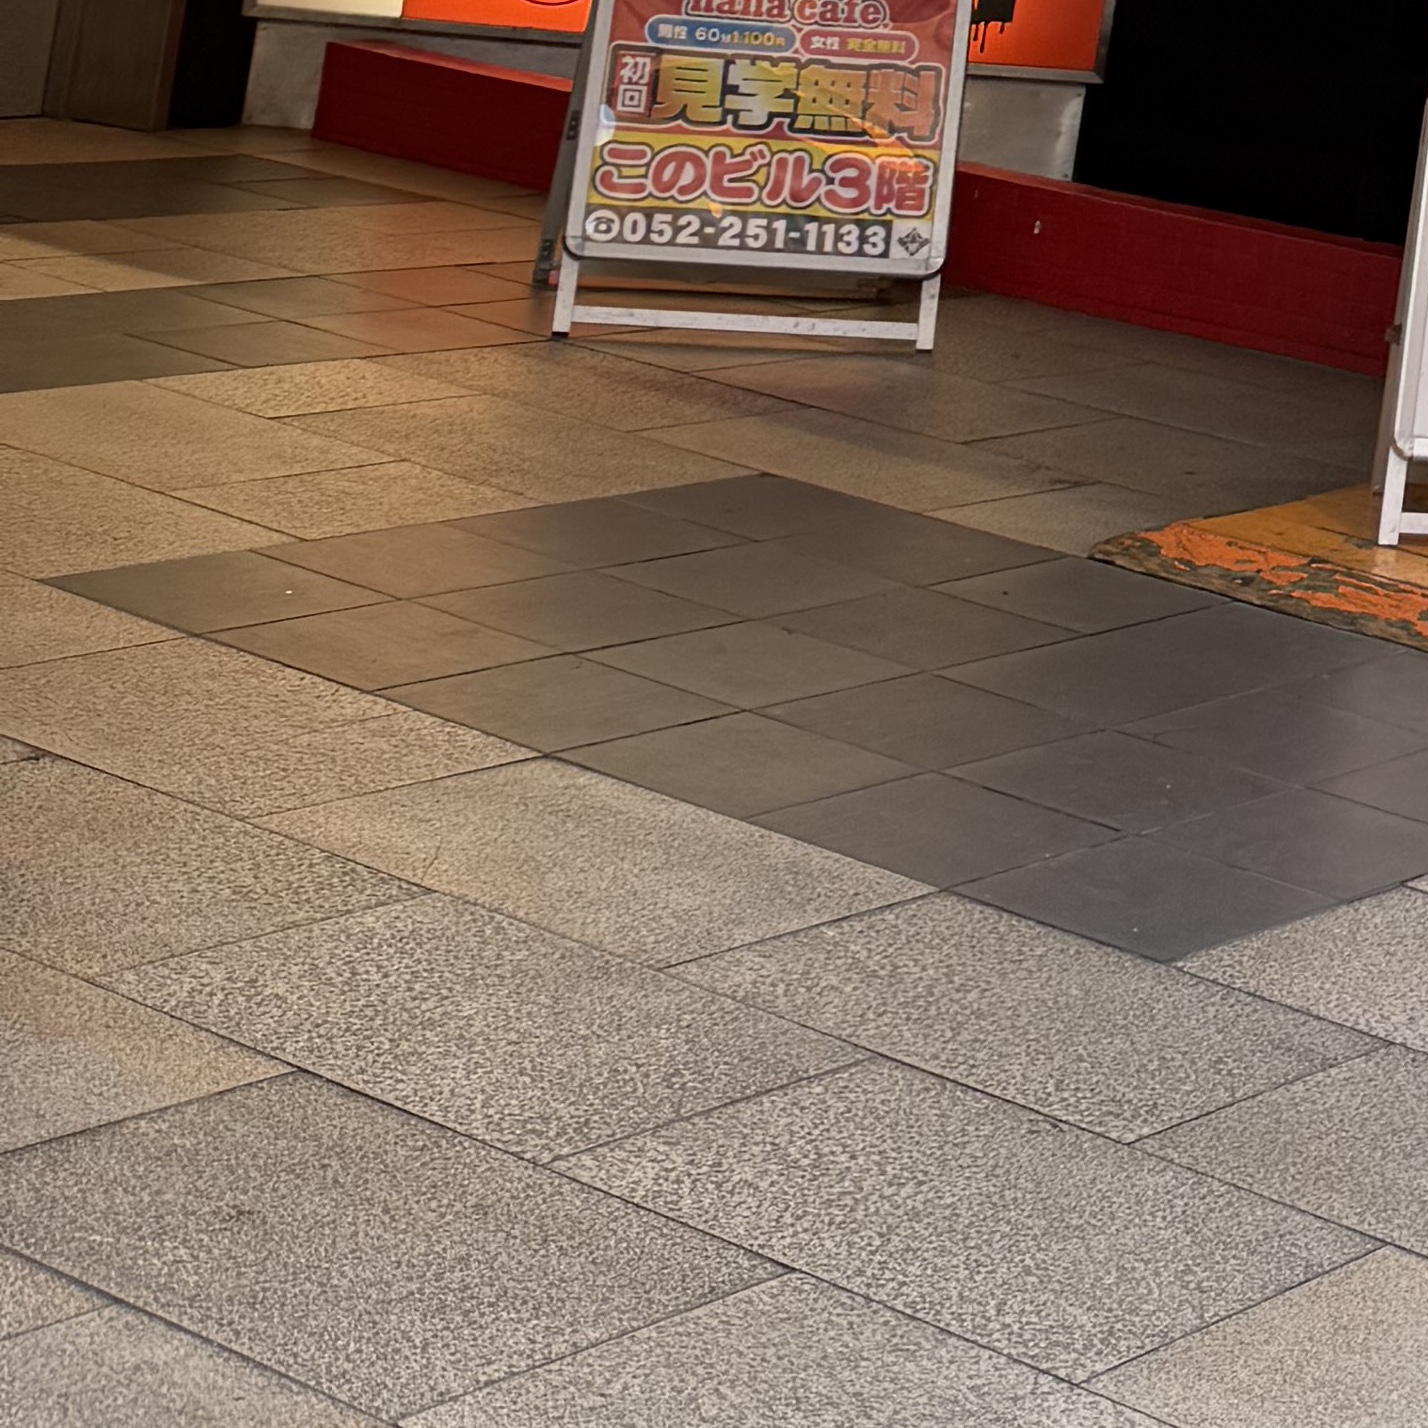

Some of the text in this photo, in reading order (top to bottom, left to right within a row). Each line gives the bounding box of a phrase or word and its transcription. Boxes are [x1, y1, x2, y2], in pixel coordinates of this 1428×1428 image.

[810, 36, 841, 52] 女性
[616, 55, 650, 114] 初回
[652, 54, 940, 139] 見学無料
[595, 142, 934, 216] このビル3階
[622, 214, 888, 257] 052-251-1133
